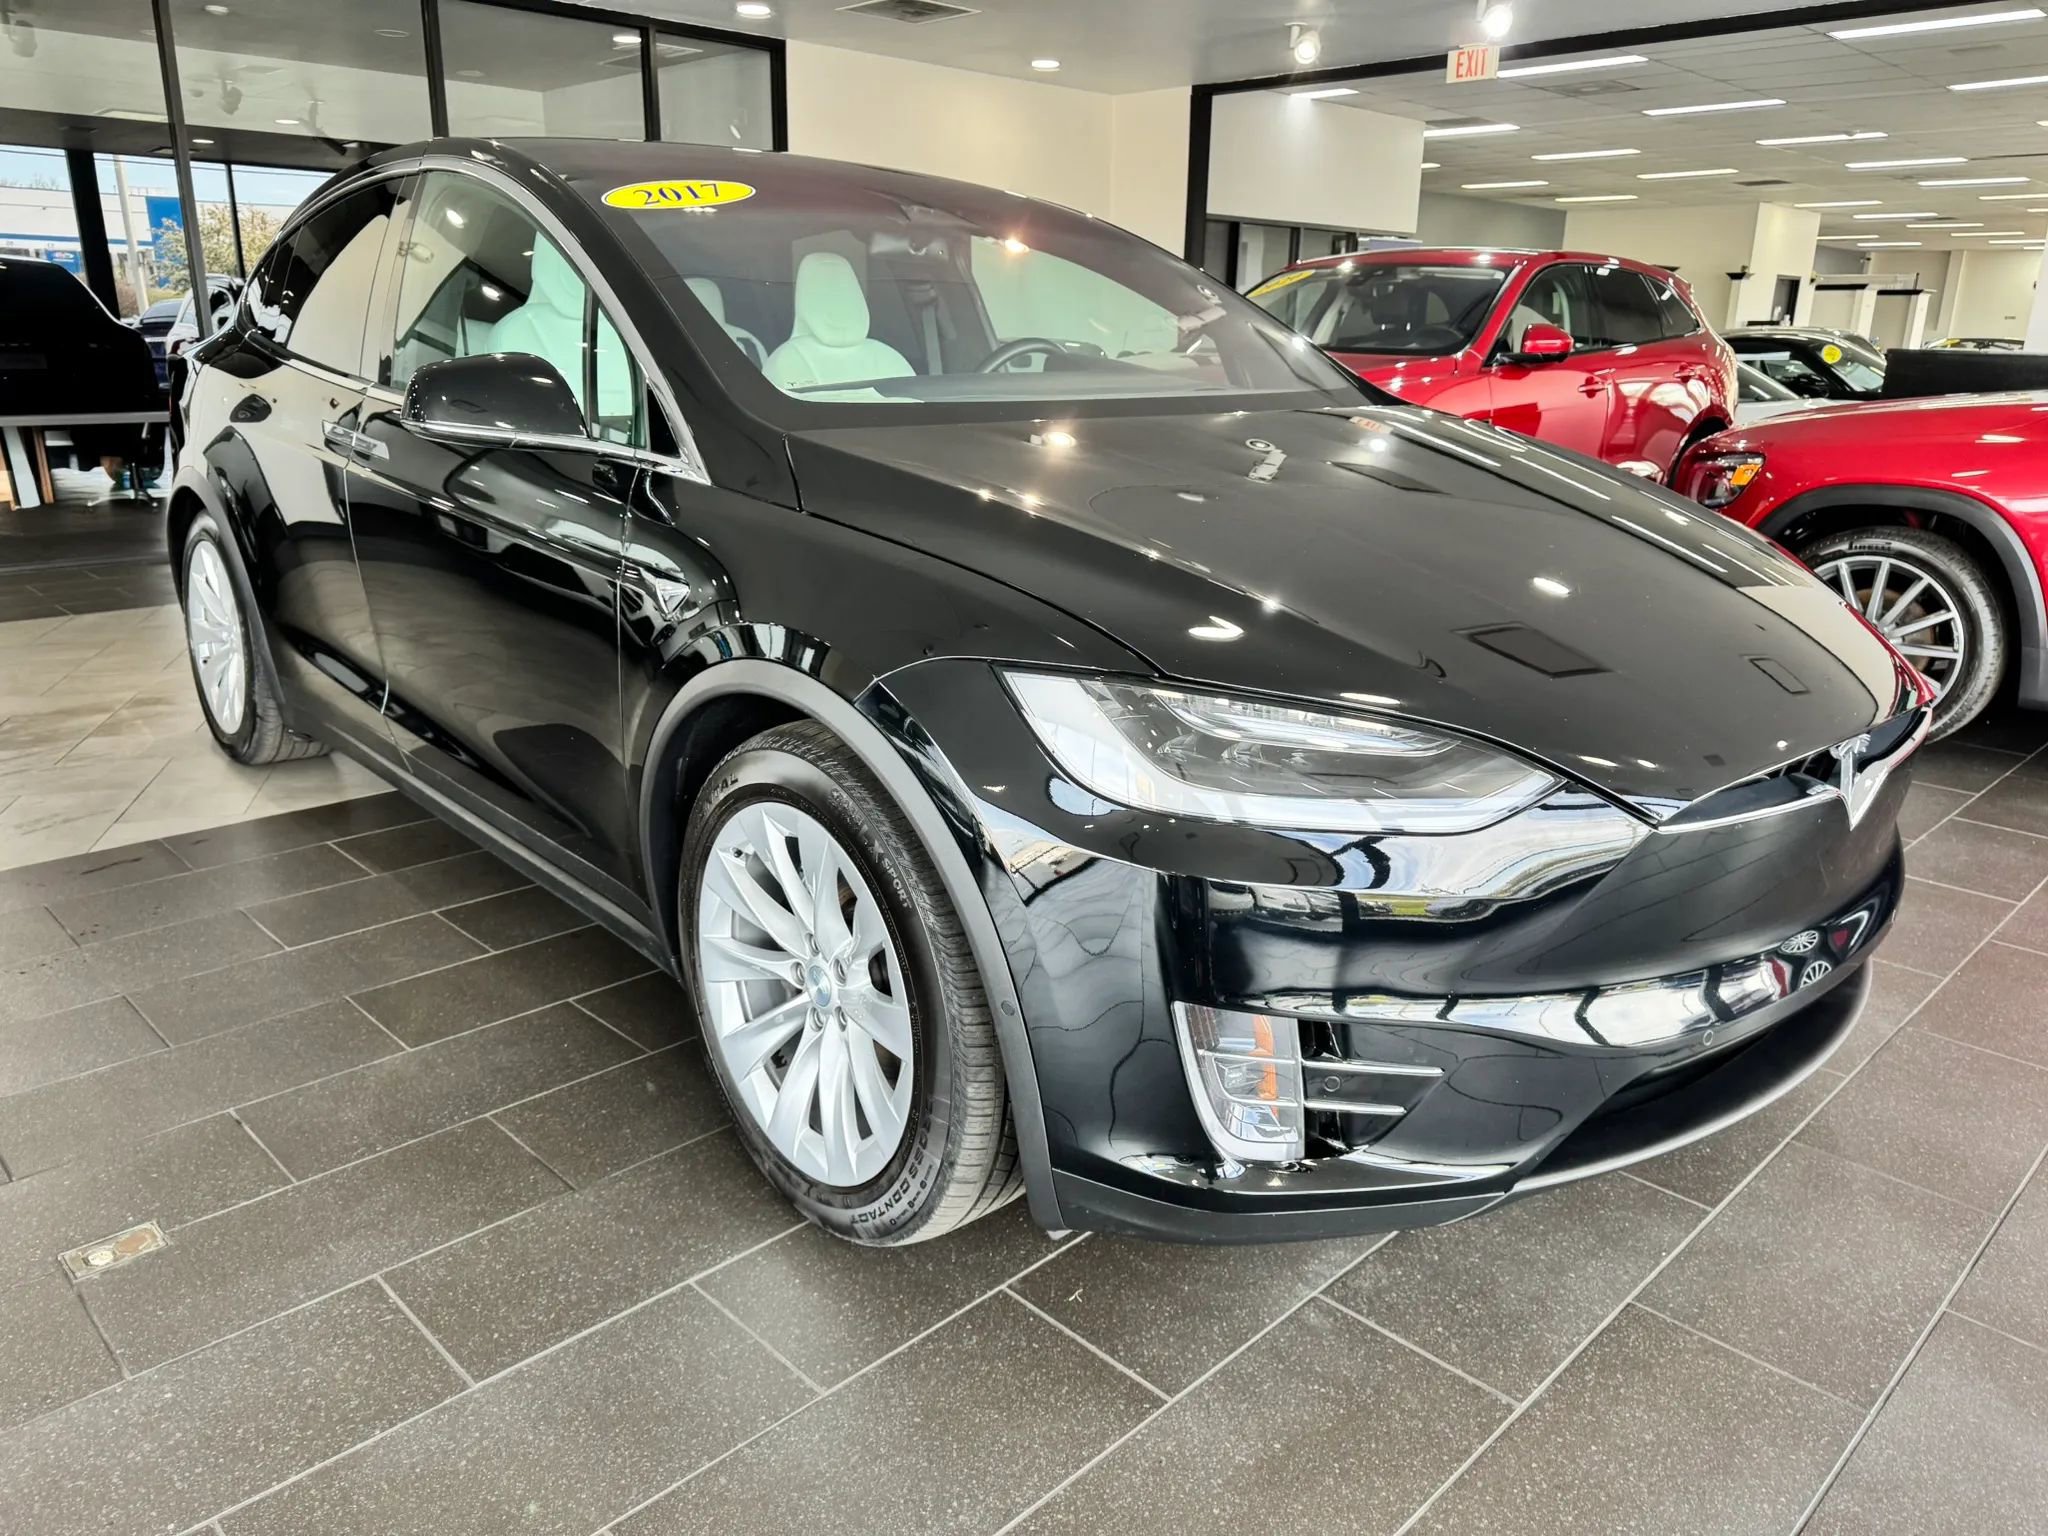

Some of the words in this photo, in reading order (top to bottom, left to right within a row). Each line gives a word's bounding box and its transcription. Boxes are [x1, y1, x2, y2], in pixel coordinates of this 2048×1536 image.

[1456, 48, 1488, 78] EXIT
[633, 183, 719, 205] 2017
[882, 858, 912, 908] SPORT
[850, 1177, 911, 1225] CONTACT
